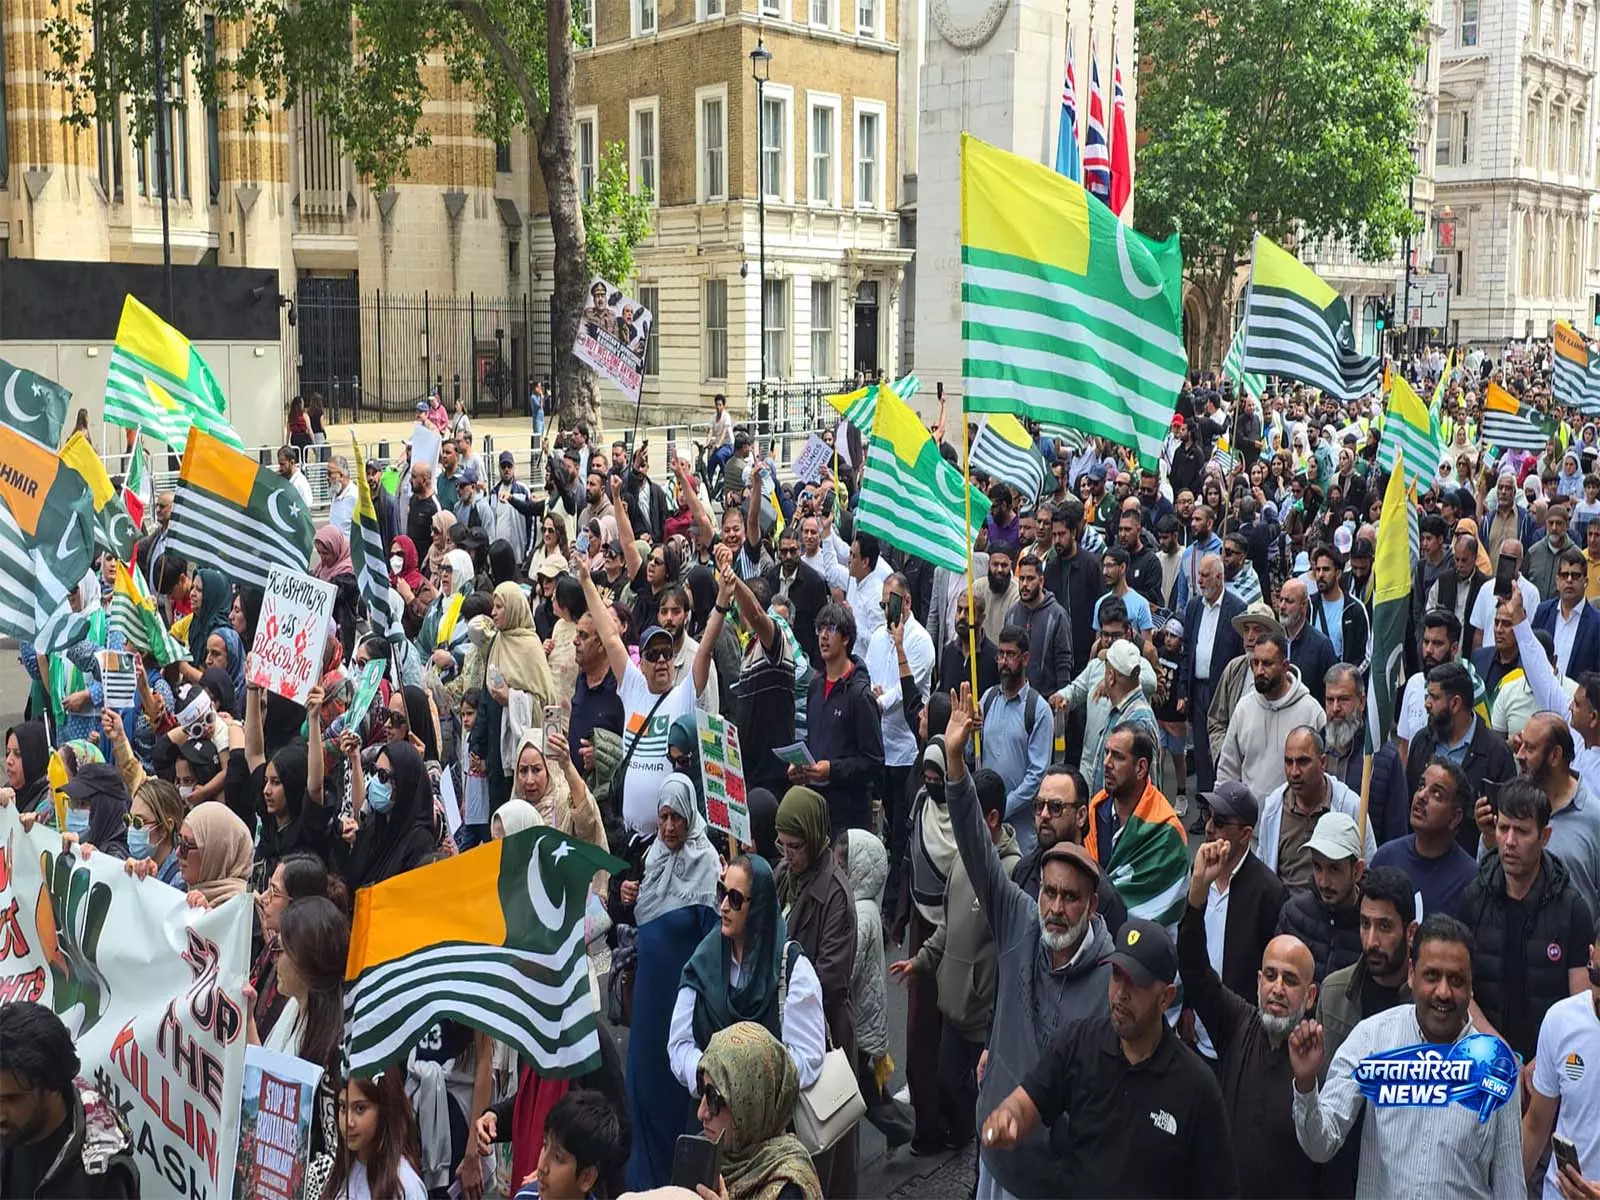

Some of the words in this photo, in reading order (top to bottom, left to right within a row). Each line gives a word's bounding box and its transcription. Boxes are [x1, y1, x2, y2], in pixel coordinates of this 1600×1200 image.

[0, 463, 38, 499] HMIR
[267, 571, 328, 616] KASHMIR
[281, 614, 297, 638] IS
[254, 632, 312, 681] BLEEDING
[157, 997, 225, 1119] THE
[109, 1016, 219, 1195] KILLIN
[265, 1080, 285, 1113] STOP
